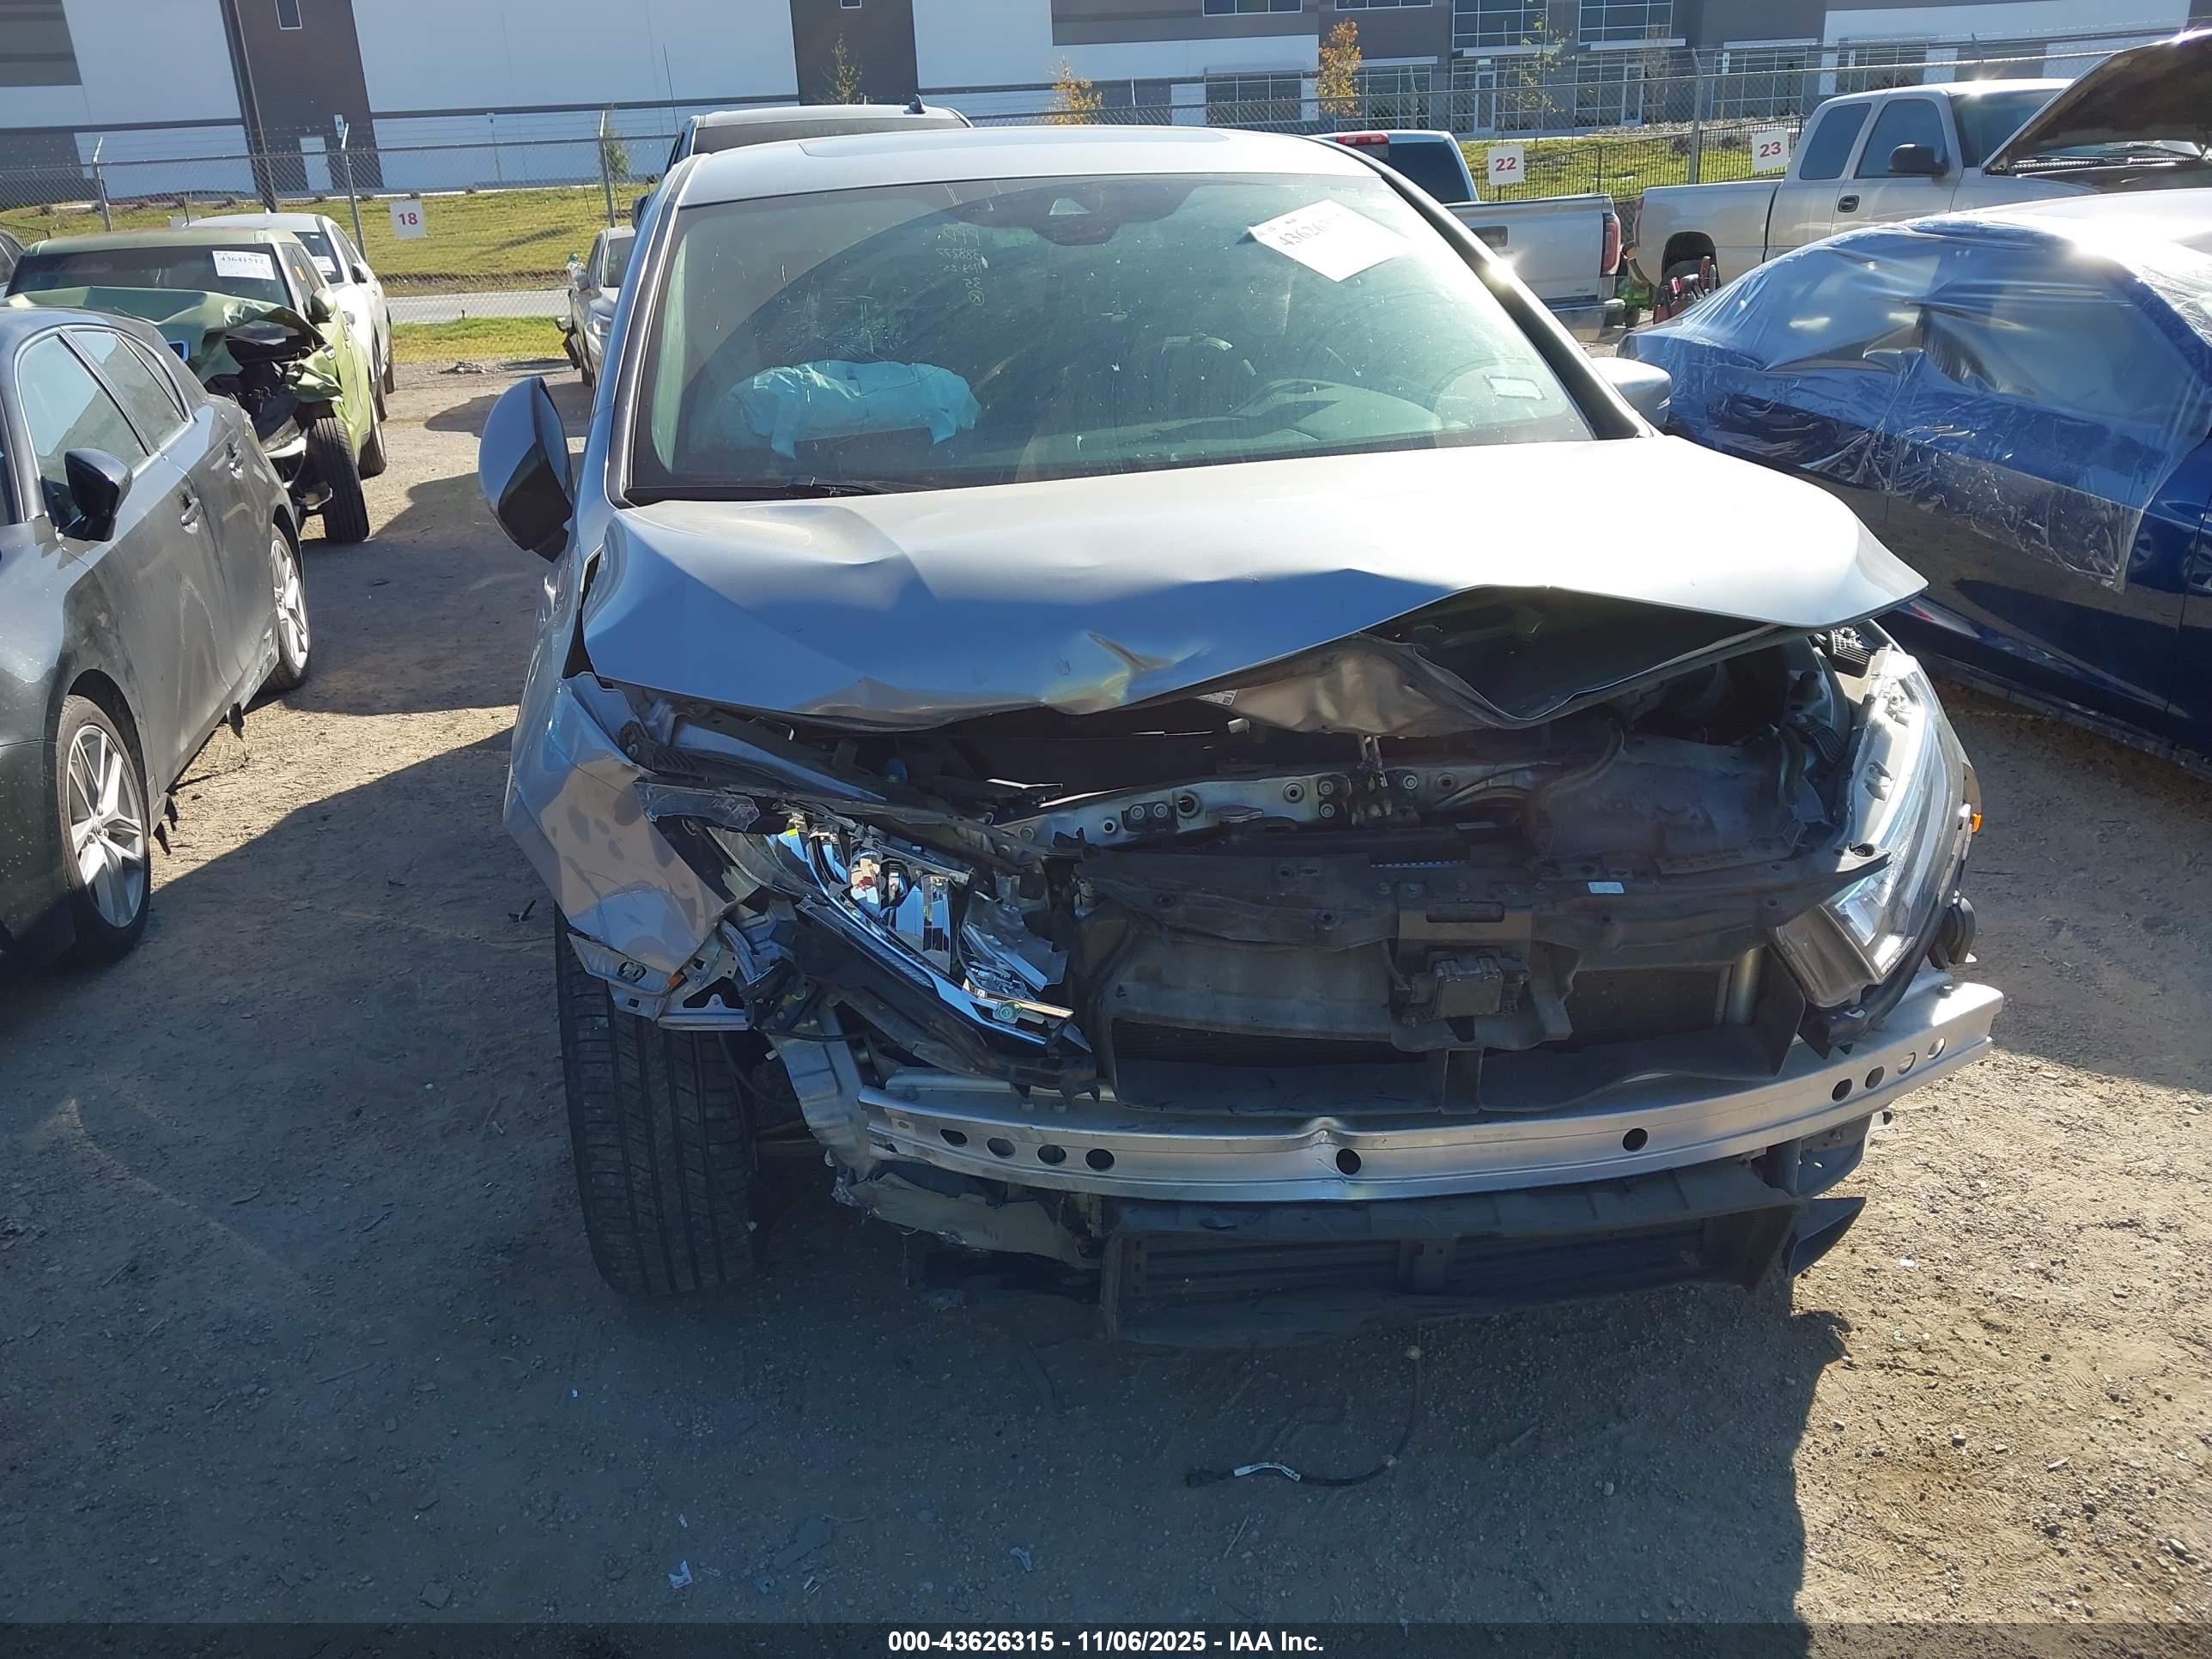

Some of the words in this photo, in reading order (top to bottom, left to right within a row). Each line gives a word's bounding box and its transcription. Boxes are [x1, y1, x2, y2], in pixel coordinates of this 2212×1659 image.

[1760, 142, 1782, 157] 23
[1496, 157, 1516, 172] 22
[398, 213, 418, 225] 18
